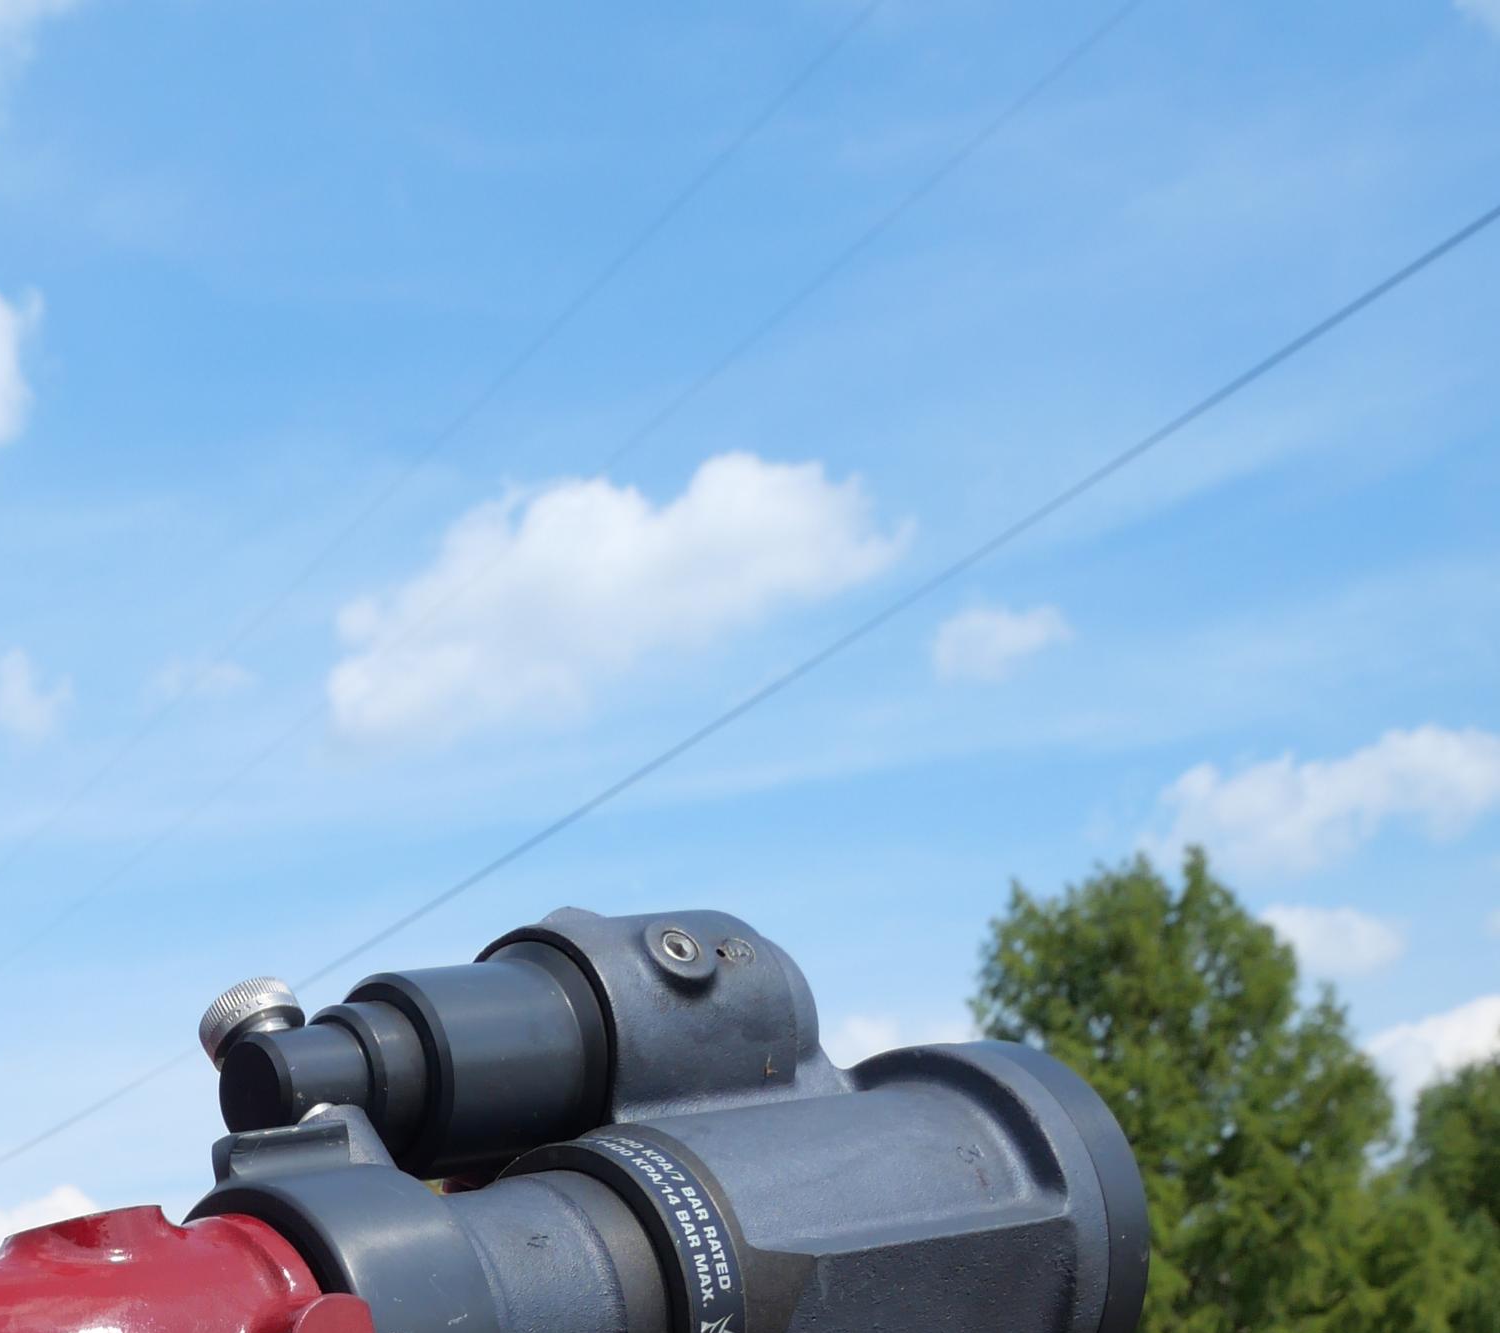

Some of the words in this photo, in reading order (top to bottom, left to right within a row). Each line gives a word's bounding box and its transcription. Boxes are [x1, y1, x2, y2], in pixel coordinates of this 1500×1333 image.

[631, 1158, 681, 1206] KPA/14
[675, 1210, 701, 1248] BAR
[693, 1254, 715, 1308] MAX.
[641, 1149, 686, 1181] KPA/7
[681, 1186, 710, 1221] BAR
[703, 1225, 732, 1291] RATED
